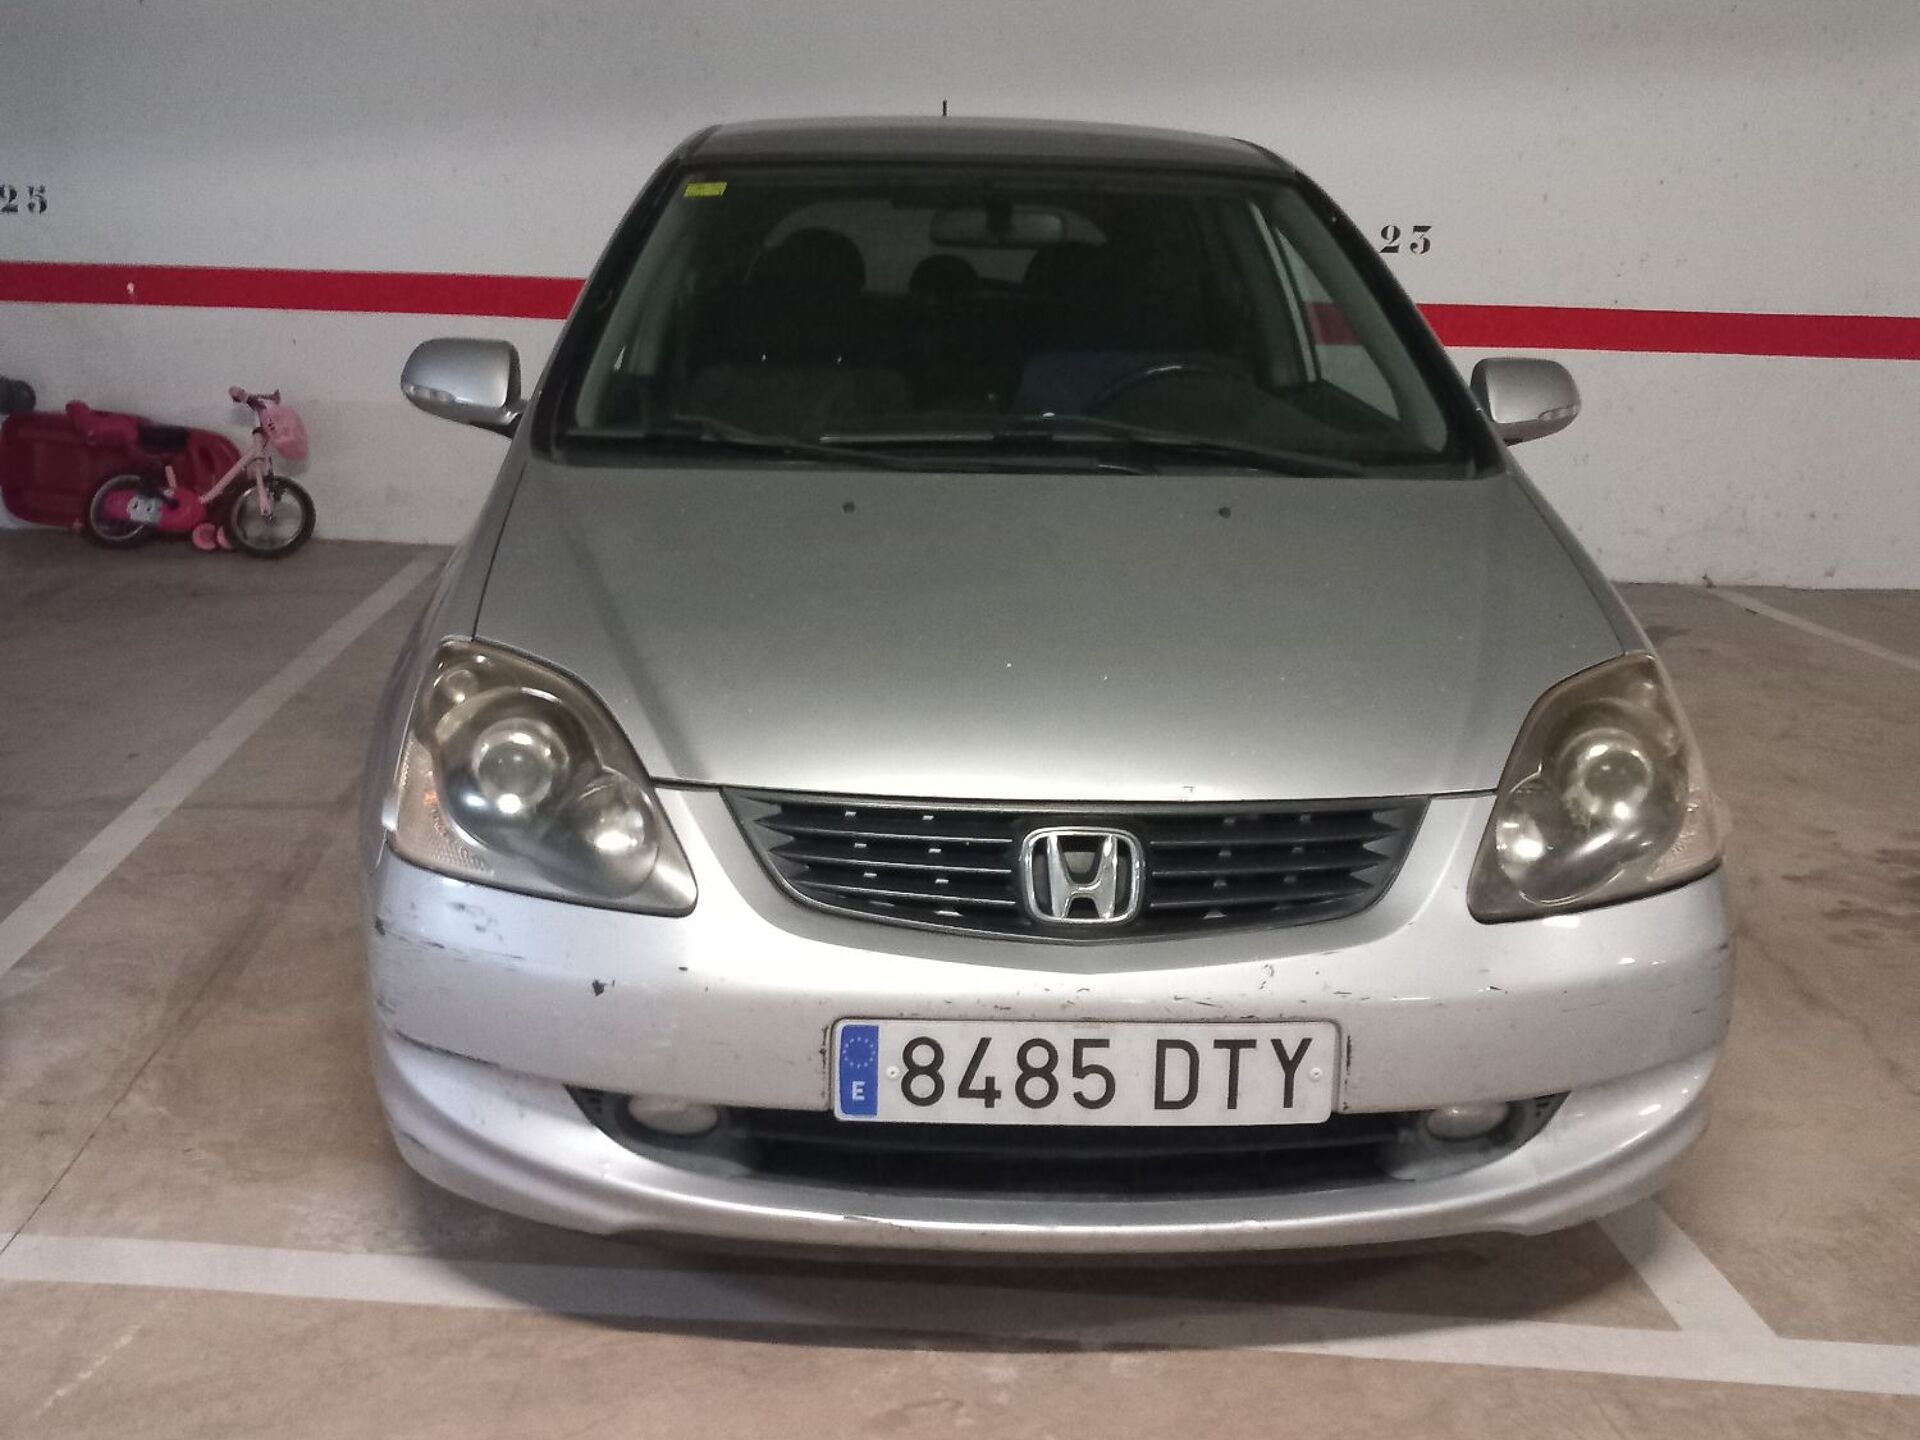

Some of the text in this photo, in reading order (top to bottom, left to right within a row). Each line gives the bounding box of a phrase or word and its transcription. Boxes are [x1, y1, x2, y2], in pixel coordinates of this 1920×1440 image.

[0, 184, 47, 214] 25
[1379, 225, 1432, 254] 23
[901, 1036, 1312, 1110] 8485 DTY
[852, 1081, 865, 1100] E
